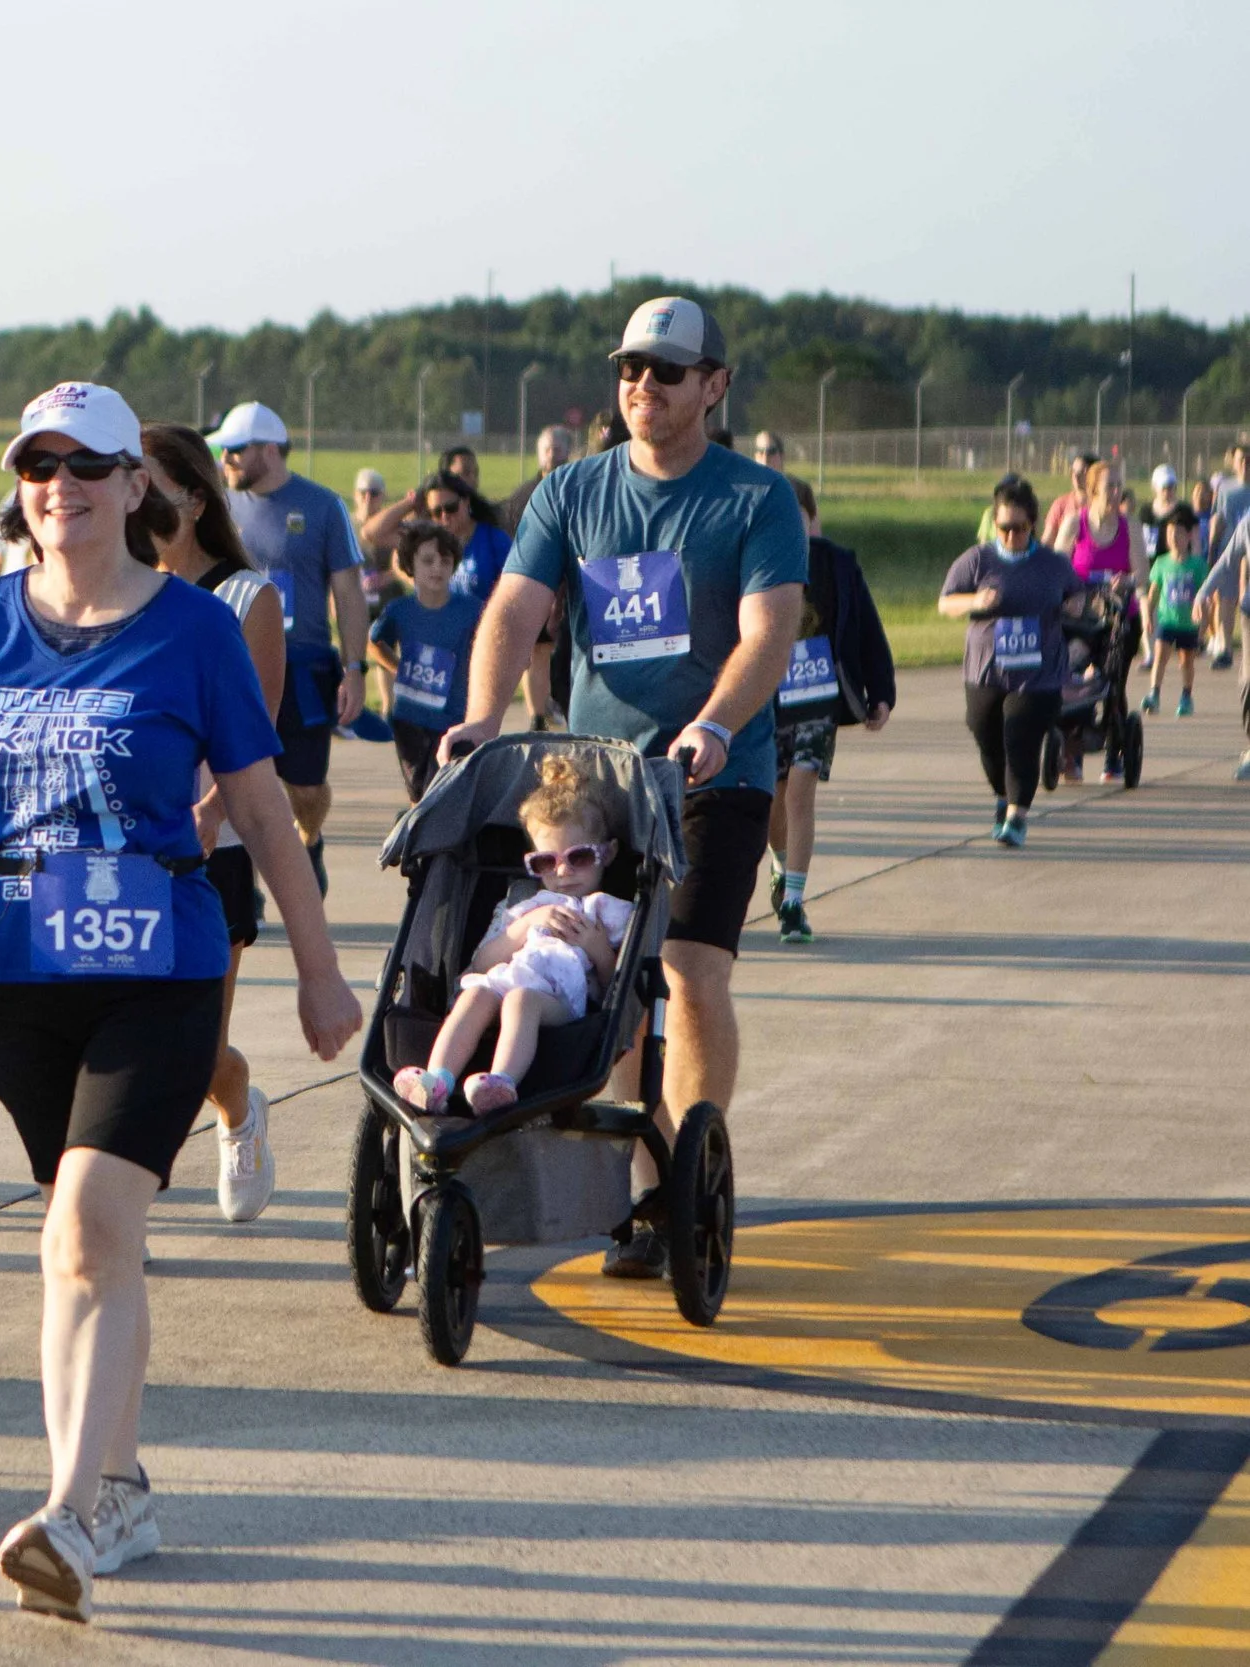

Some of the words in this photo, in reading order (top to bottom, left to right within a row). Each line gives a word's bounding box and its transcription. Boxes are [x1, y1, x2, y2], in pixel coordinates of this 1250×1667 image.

[604, 592, 661, 626] 441
[403, 661, 447, 690] 1234
[54, 728, 133, 757] 10K
[31, 826, 79, 847] THE
[45, 907, 161, 951] 1357
